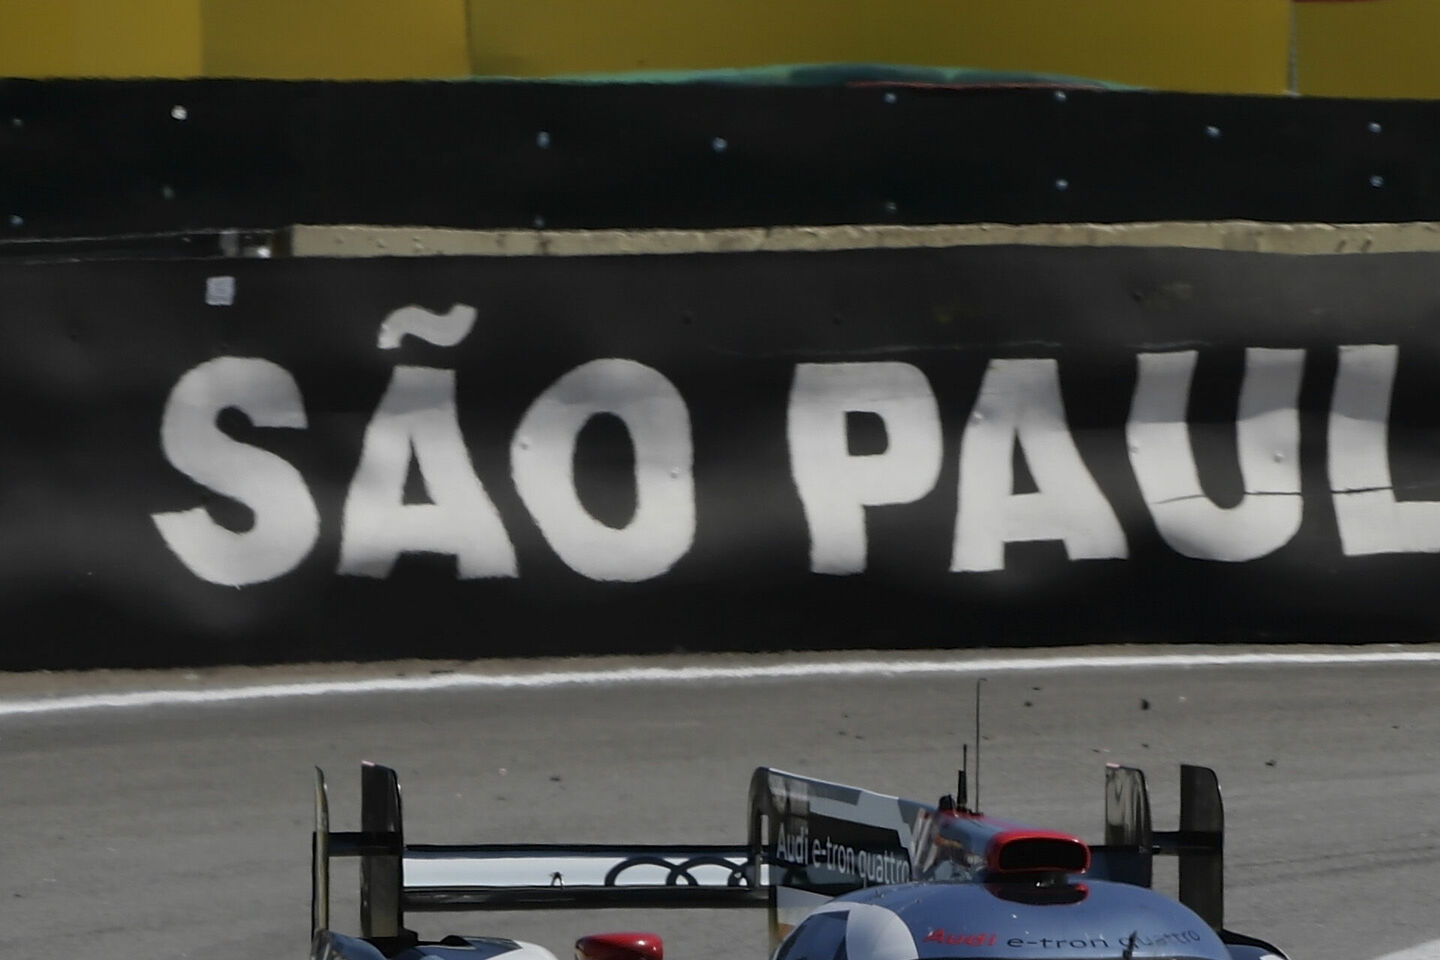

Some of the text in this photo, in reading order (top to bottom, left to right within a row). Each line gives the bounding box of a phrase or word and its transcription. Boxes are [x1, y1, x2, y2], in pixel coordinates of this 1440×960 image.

[152, 303, 697, 589] SÃO
[776, 822, 910, 889] Audi e-tron quattro
[922, 928, 997, 947] Audi
[1007, 935, 1109, 949] e-tron
